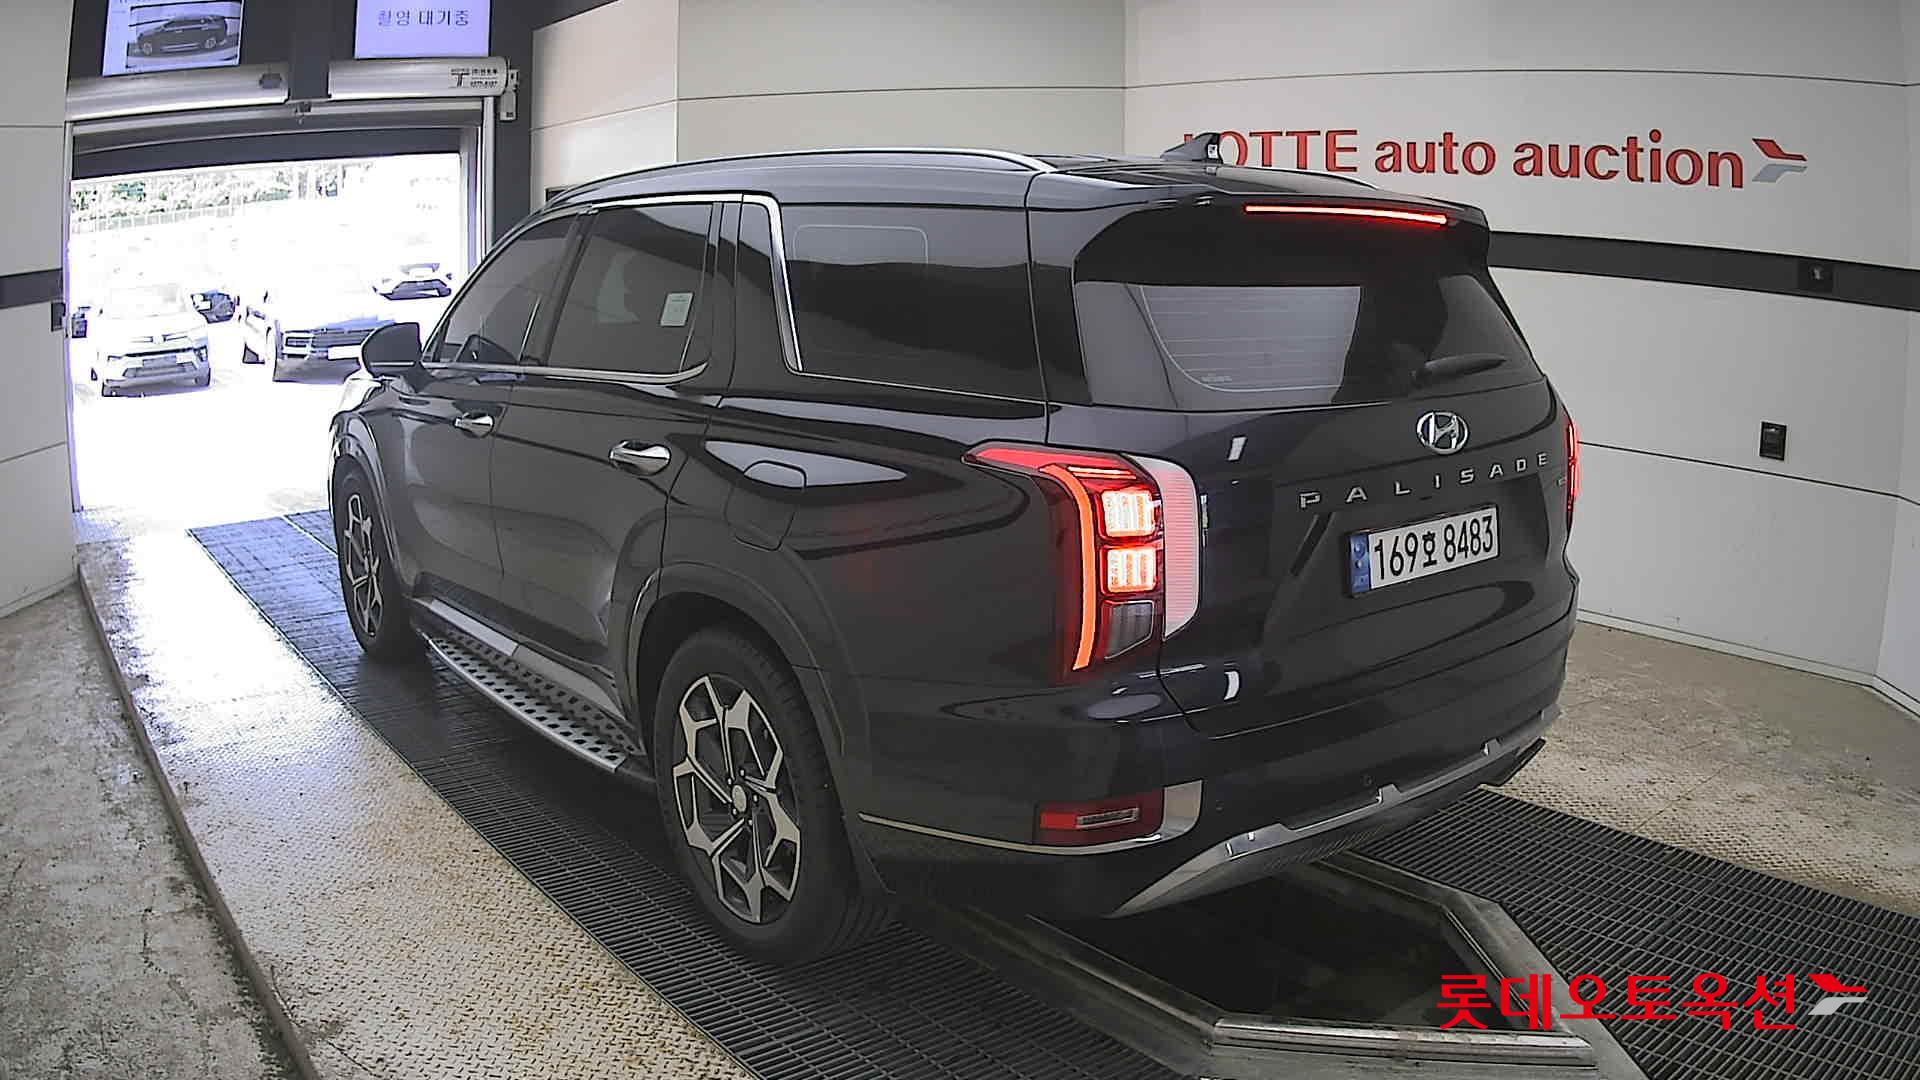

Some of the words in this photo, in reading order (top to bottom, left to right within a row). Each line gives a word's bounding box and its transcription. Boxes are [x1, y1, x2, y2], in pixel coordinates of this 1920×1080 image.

[418, 10, 469, 26] 대기중
[1375, 131, 1497, 176] auto
[1512, 128, 1744, 189] auction
[1300, 452, 1550, 508] PALISADE
[1374, 530, 1438, 580] 169호
[1443, 514, 1494, 563] 8483
